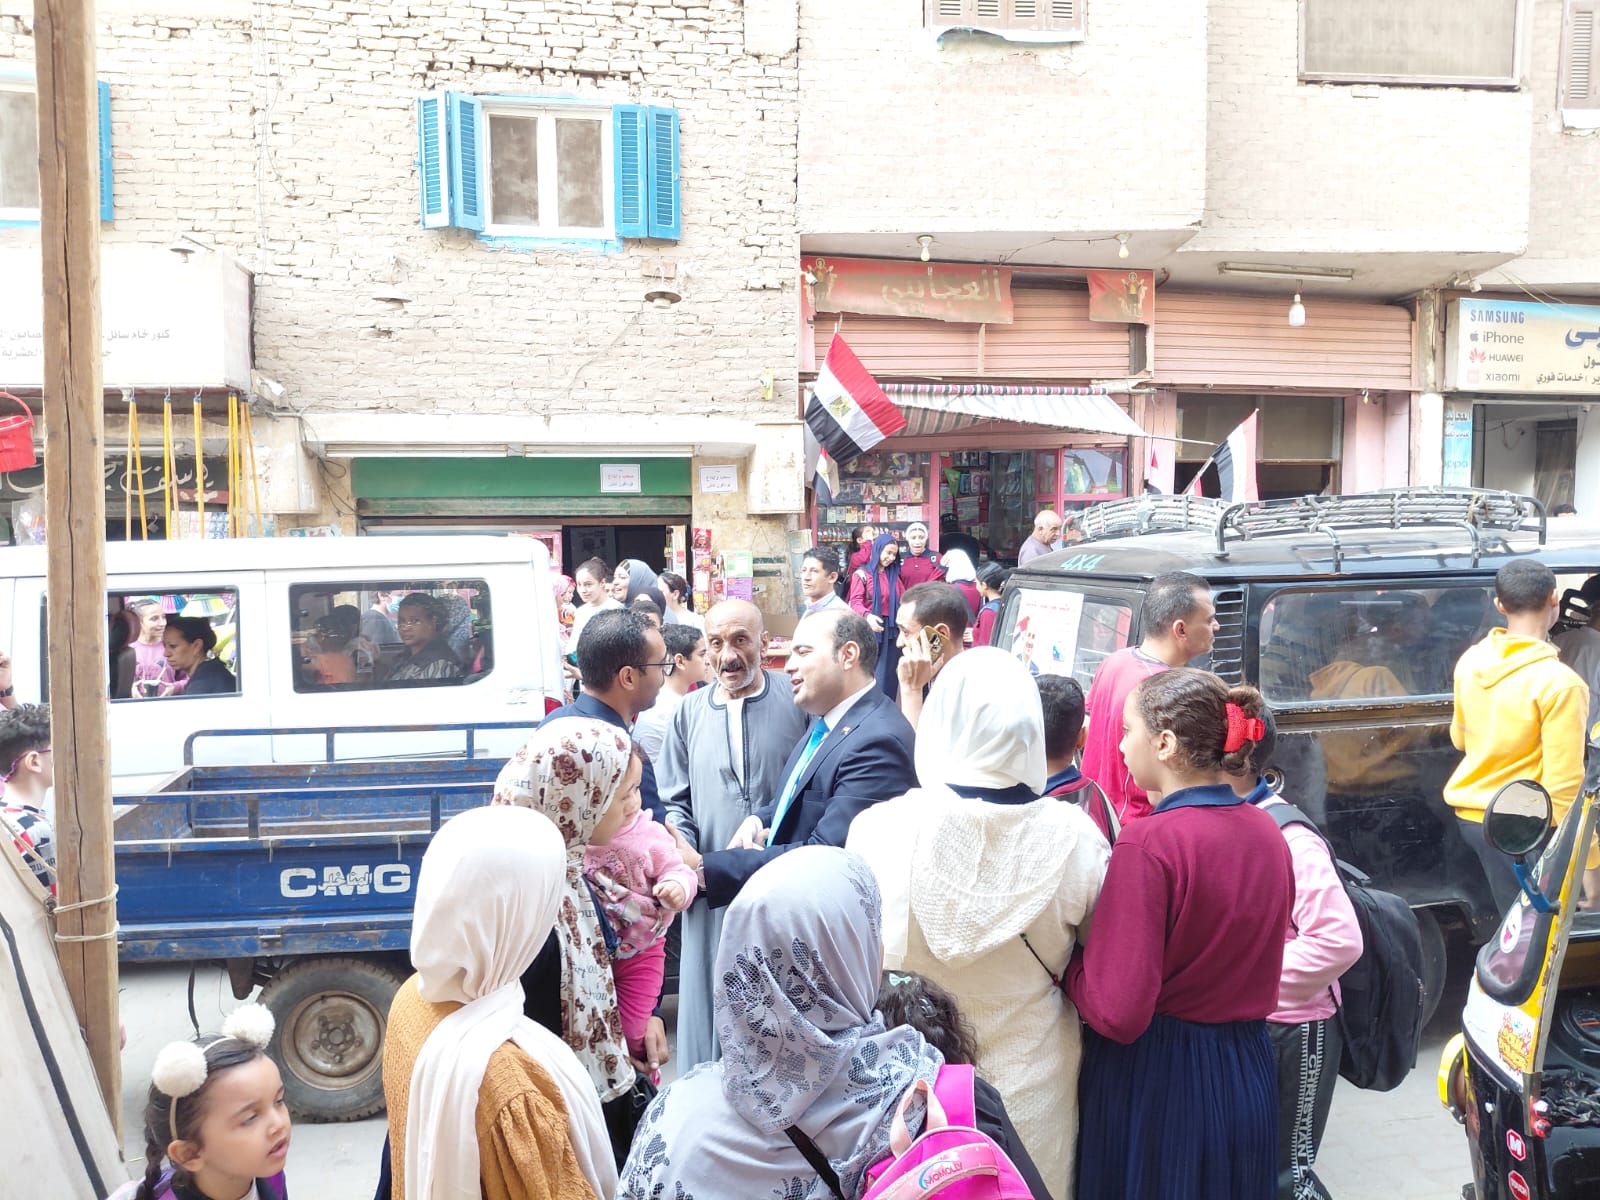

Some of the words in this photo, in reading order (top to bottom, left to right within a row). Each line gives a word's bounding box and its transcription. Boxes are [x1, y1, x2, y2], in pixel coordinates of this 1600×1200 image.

[1470, 309, 1525, 324] SAMSUNG
[1482, 331, 1525, 344] iPhone
[1488, 353, 1524, 363] HUAWEI
[280, 863, 411, 898] CMG
[1297, 1053, 1320, 1157] CHRISTIAN
[1509, 1134, 1523, 1157] M
